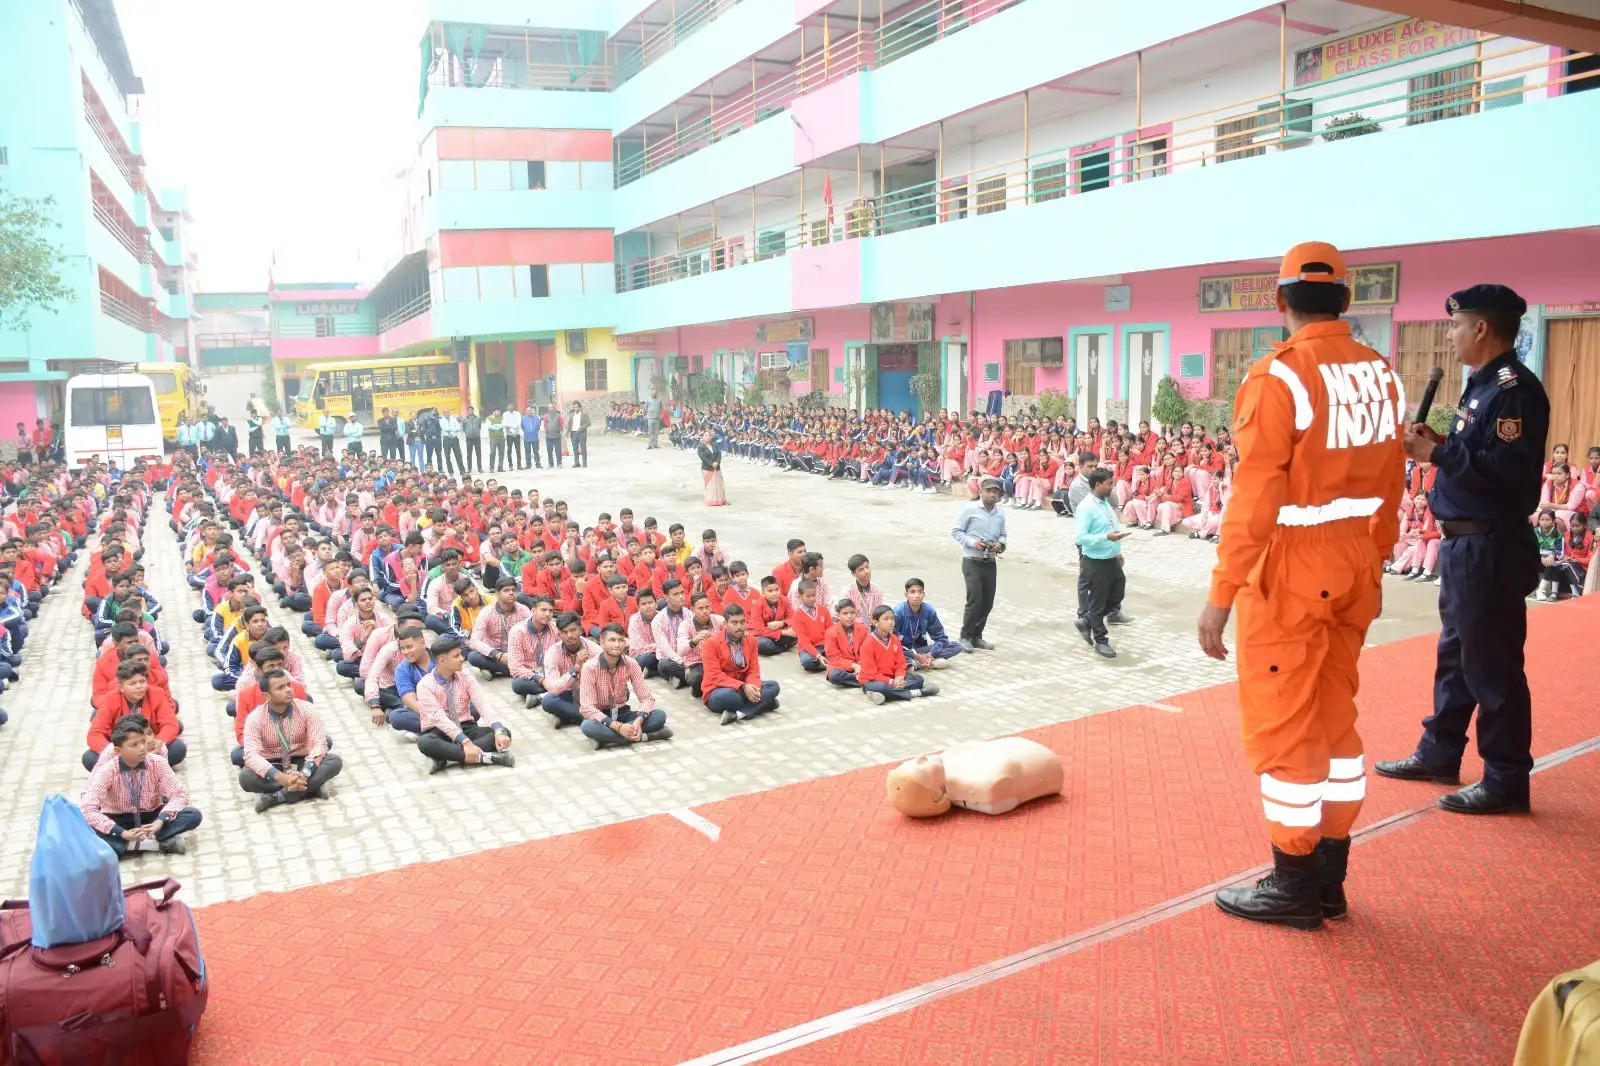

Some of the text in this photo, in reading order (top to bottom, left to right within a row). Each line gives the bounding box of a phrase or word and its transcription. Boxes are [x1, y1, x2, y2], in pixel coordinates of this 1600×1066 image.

[1325, 26, 1395, 61] DELUXE
[1333, 28, 1490, 75] CLASS FOR KID
[1318, 360, 1391, 407] NDRF
[1326, 400, 1396, 450] INDIA
